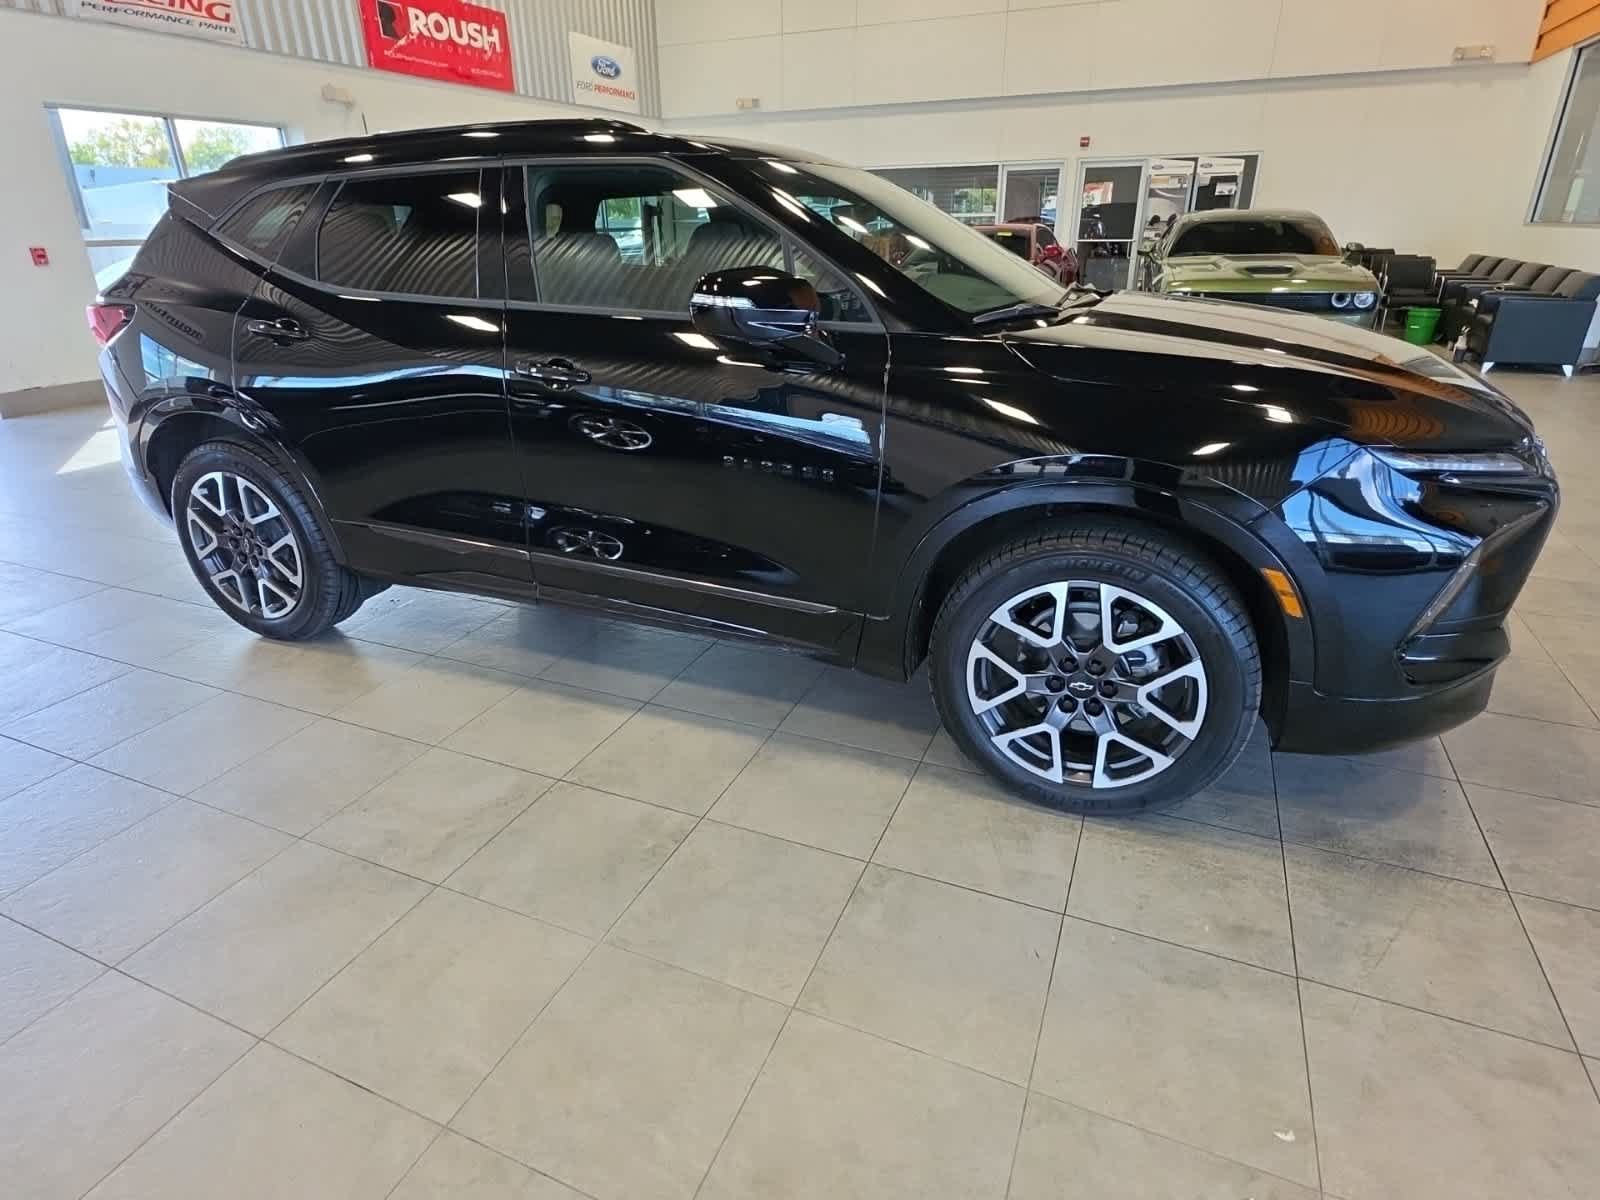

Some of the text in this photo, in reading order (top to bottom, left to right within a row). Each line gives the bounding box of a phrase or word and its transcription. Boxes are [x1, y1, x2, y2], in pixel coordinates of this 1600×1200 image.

[80, 1, 237, 34] PERFORMANCE PARTS
[407, 7, 502, 54] ROUSH
[594, 84, 636, 101] PERFORMANCE
